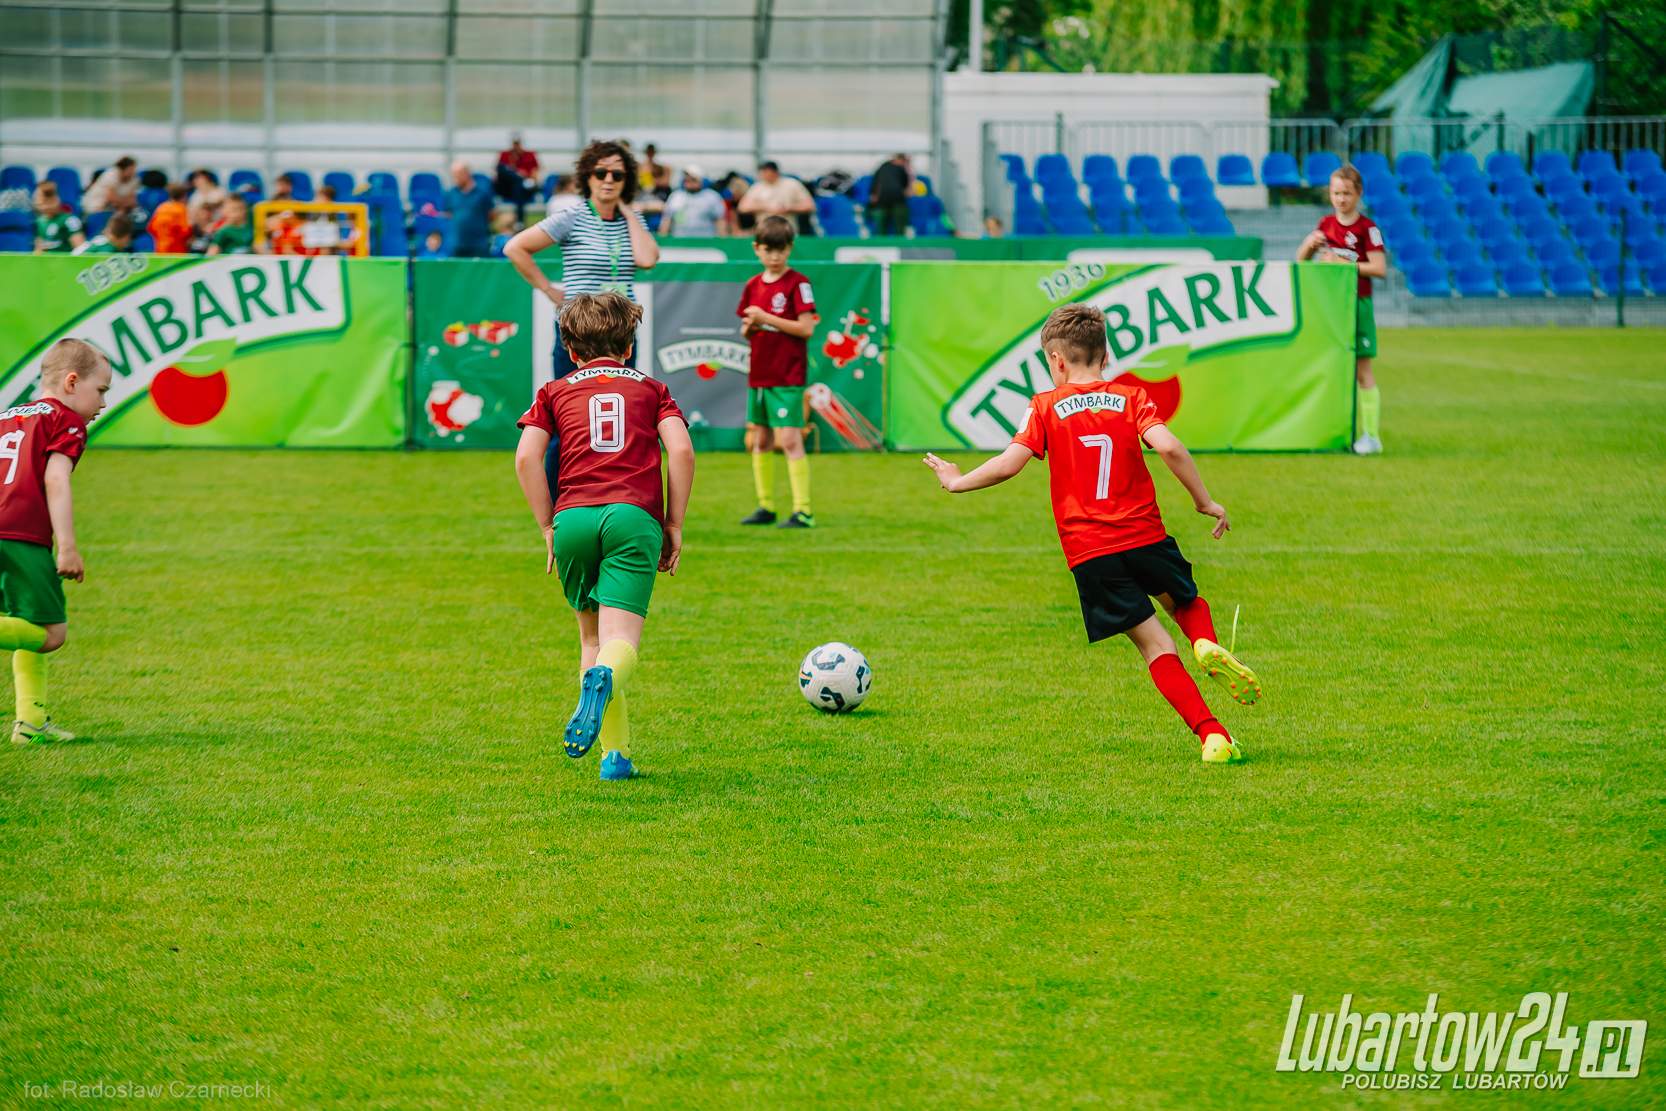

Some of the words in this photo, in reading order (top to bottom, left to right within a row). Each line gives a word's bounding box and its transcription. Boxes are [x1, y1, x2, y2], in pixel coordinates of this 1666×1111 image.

[970, 262, 1277, 437] TYBARK
[588, 392, 625, 453] 8
[1057, 395, 1121, 414] TYMBARK
[0, 429, 26, 485] 9
[1077, 433, 1113, 500] 7
